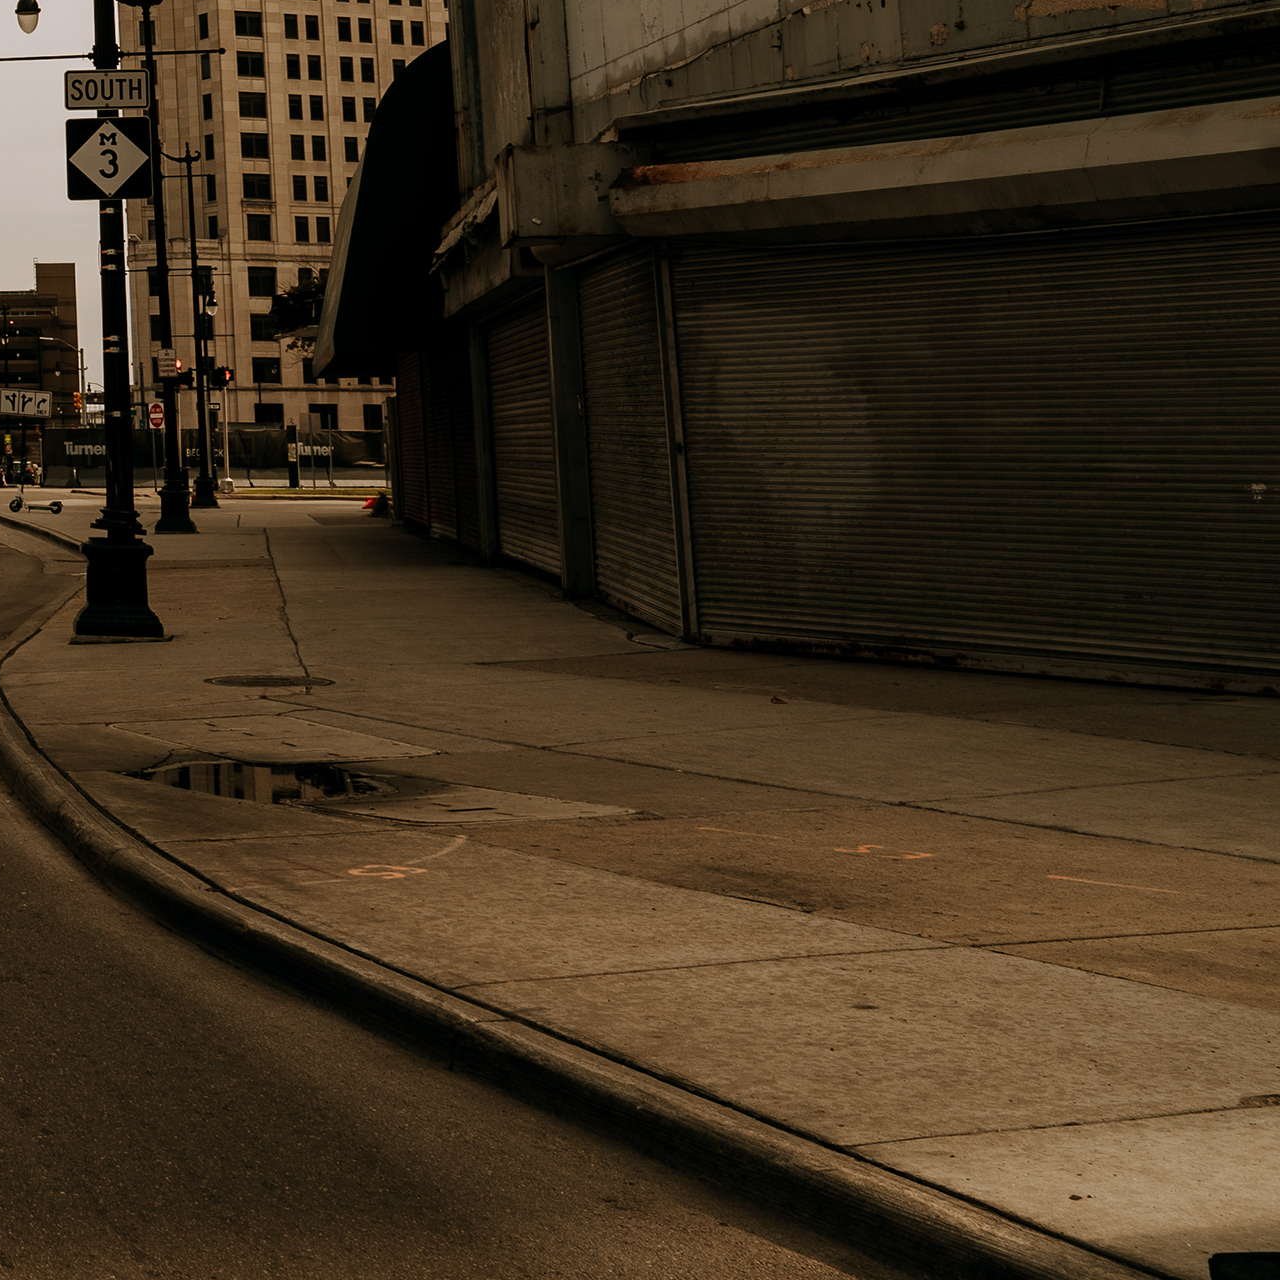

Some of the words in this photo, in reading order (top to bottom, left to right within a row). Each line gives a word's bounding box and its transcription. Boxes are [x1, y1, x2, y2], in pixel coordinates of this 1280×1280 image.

[70, 78, 143, 102] SOUTH
[98, 132, 118, 146] M
[98, 149, 120, 179] 3
[297, 442, 335, 457] Turner
